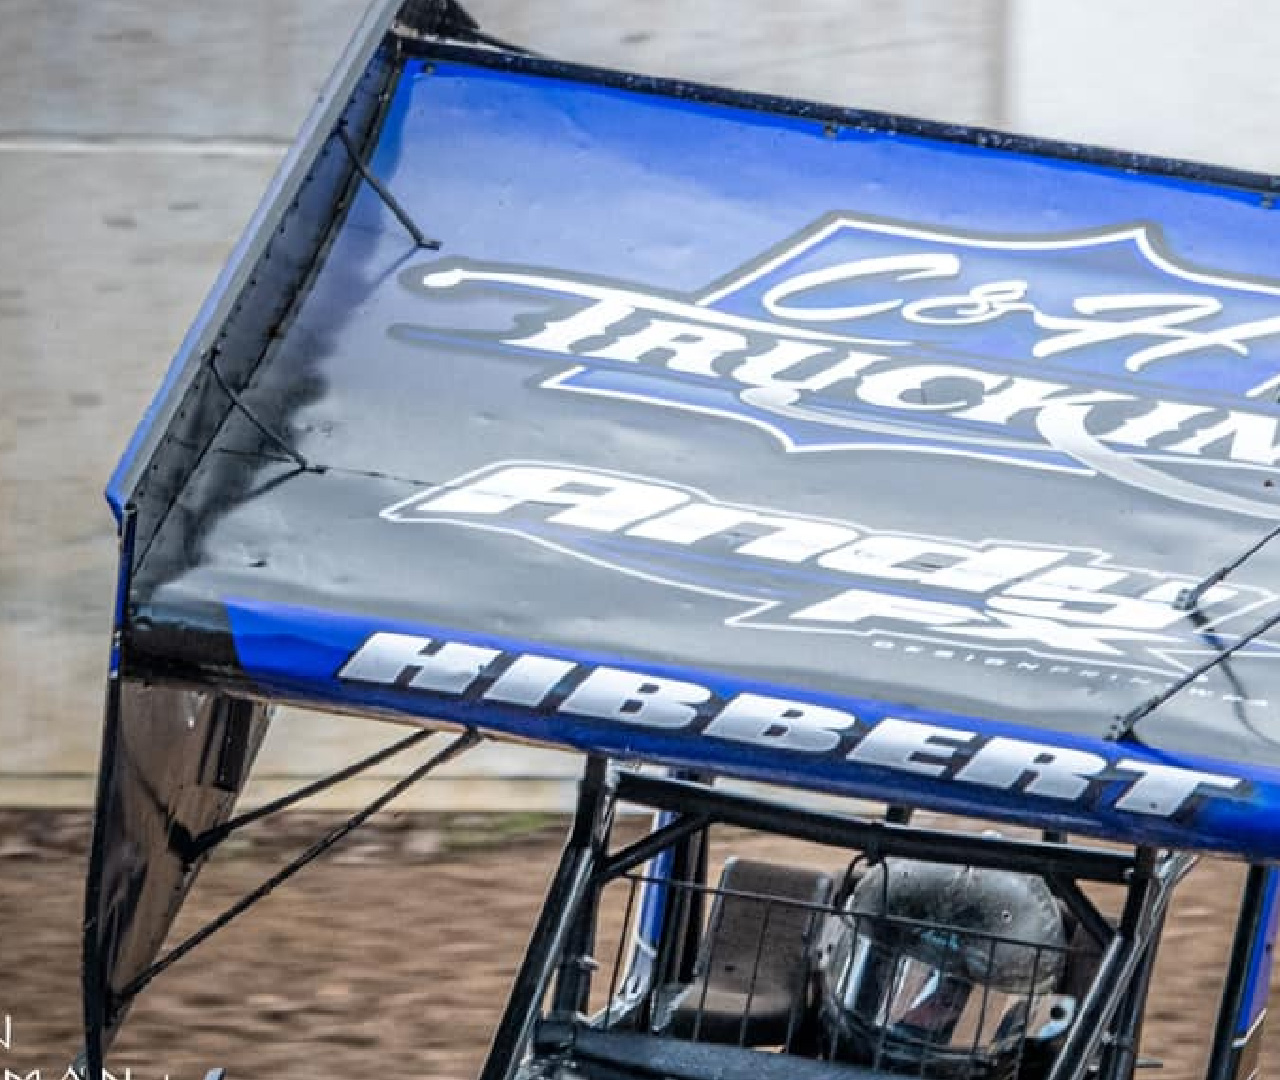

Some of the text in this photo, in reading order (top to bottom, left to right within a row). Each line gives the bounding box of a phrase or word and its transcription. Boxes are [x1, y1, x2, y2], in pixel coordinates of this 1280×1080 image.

[417, 463, 1239, 629] Andy
[788, 588, 1193, 656] FX
[337, 630, 1240, 817] HIBBERT
